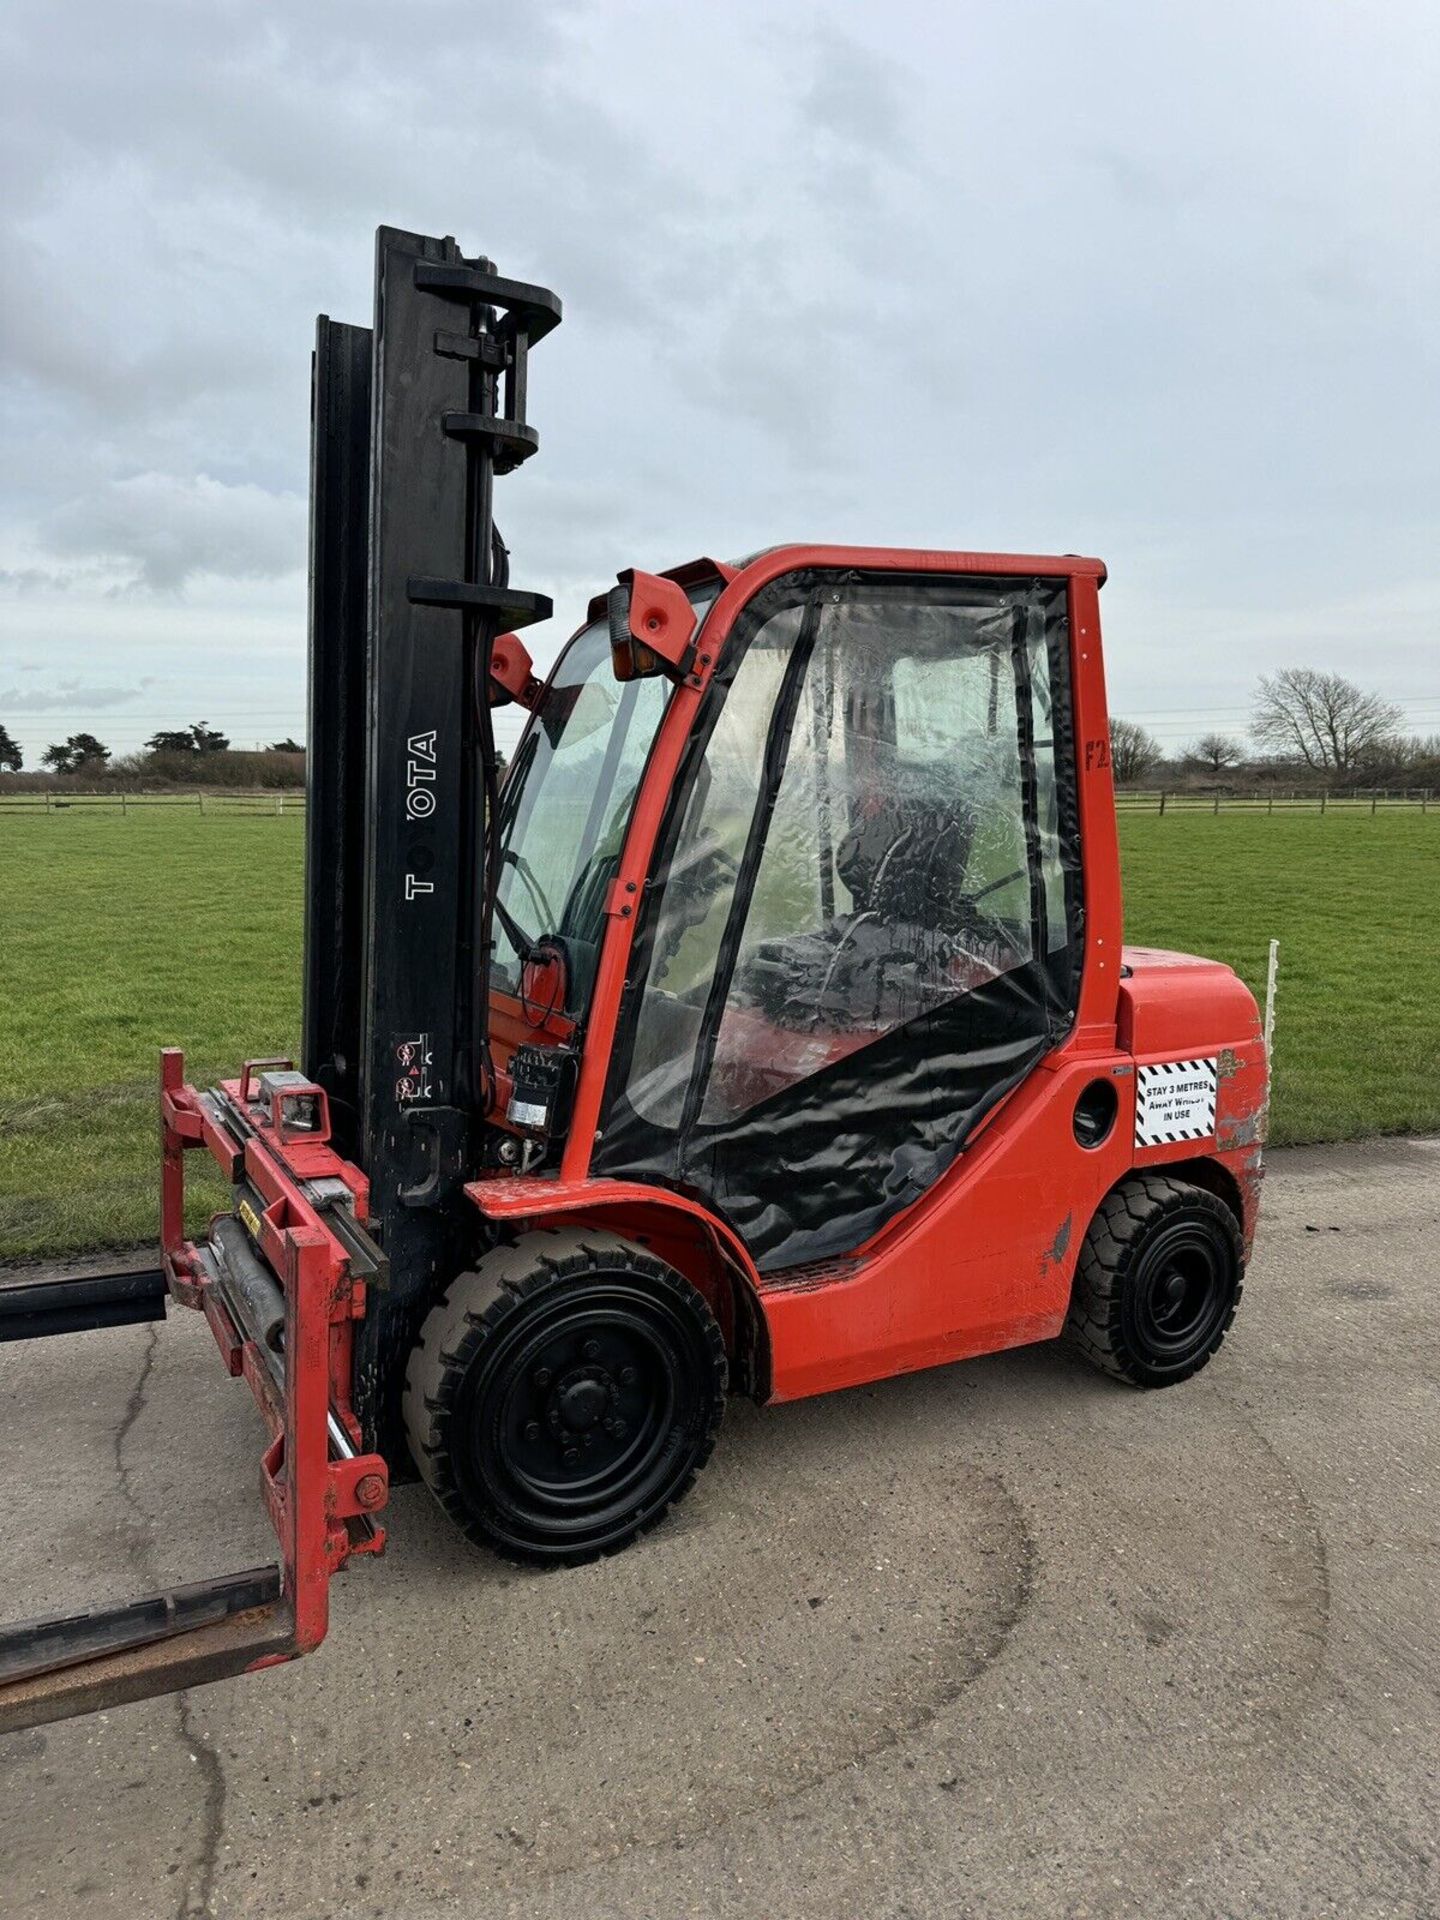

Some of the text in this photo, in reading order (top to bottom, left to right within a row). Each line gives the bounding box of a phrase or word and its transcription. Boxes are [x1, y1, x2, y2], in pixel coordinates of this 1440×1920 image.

[405, 730, 437, 901] TOTA
[1146, 1080, 1208, 1097] STAY 3 METRES
[1163, 1109, 1190, 1121] IN USE
